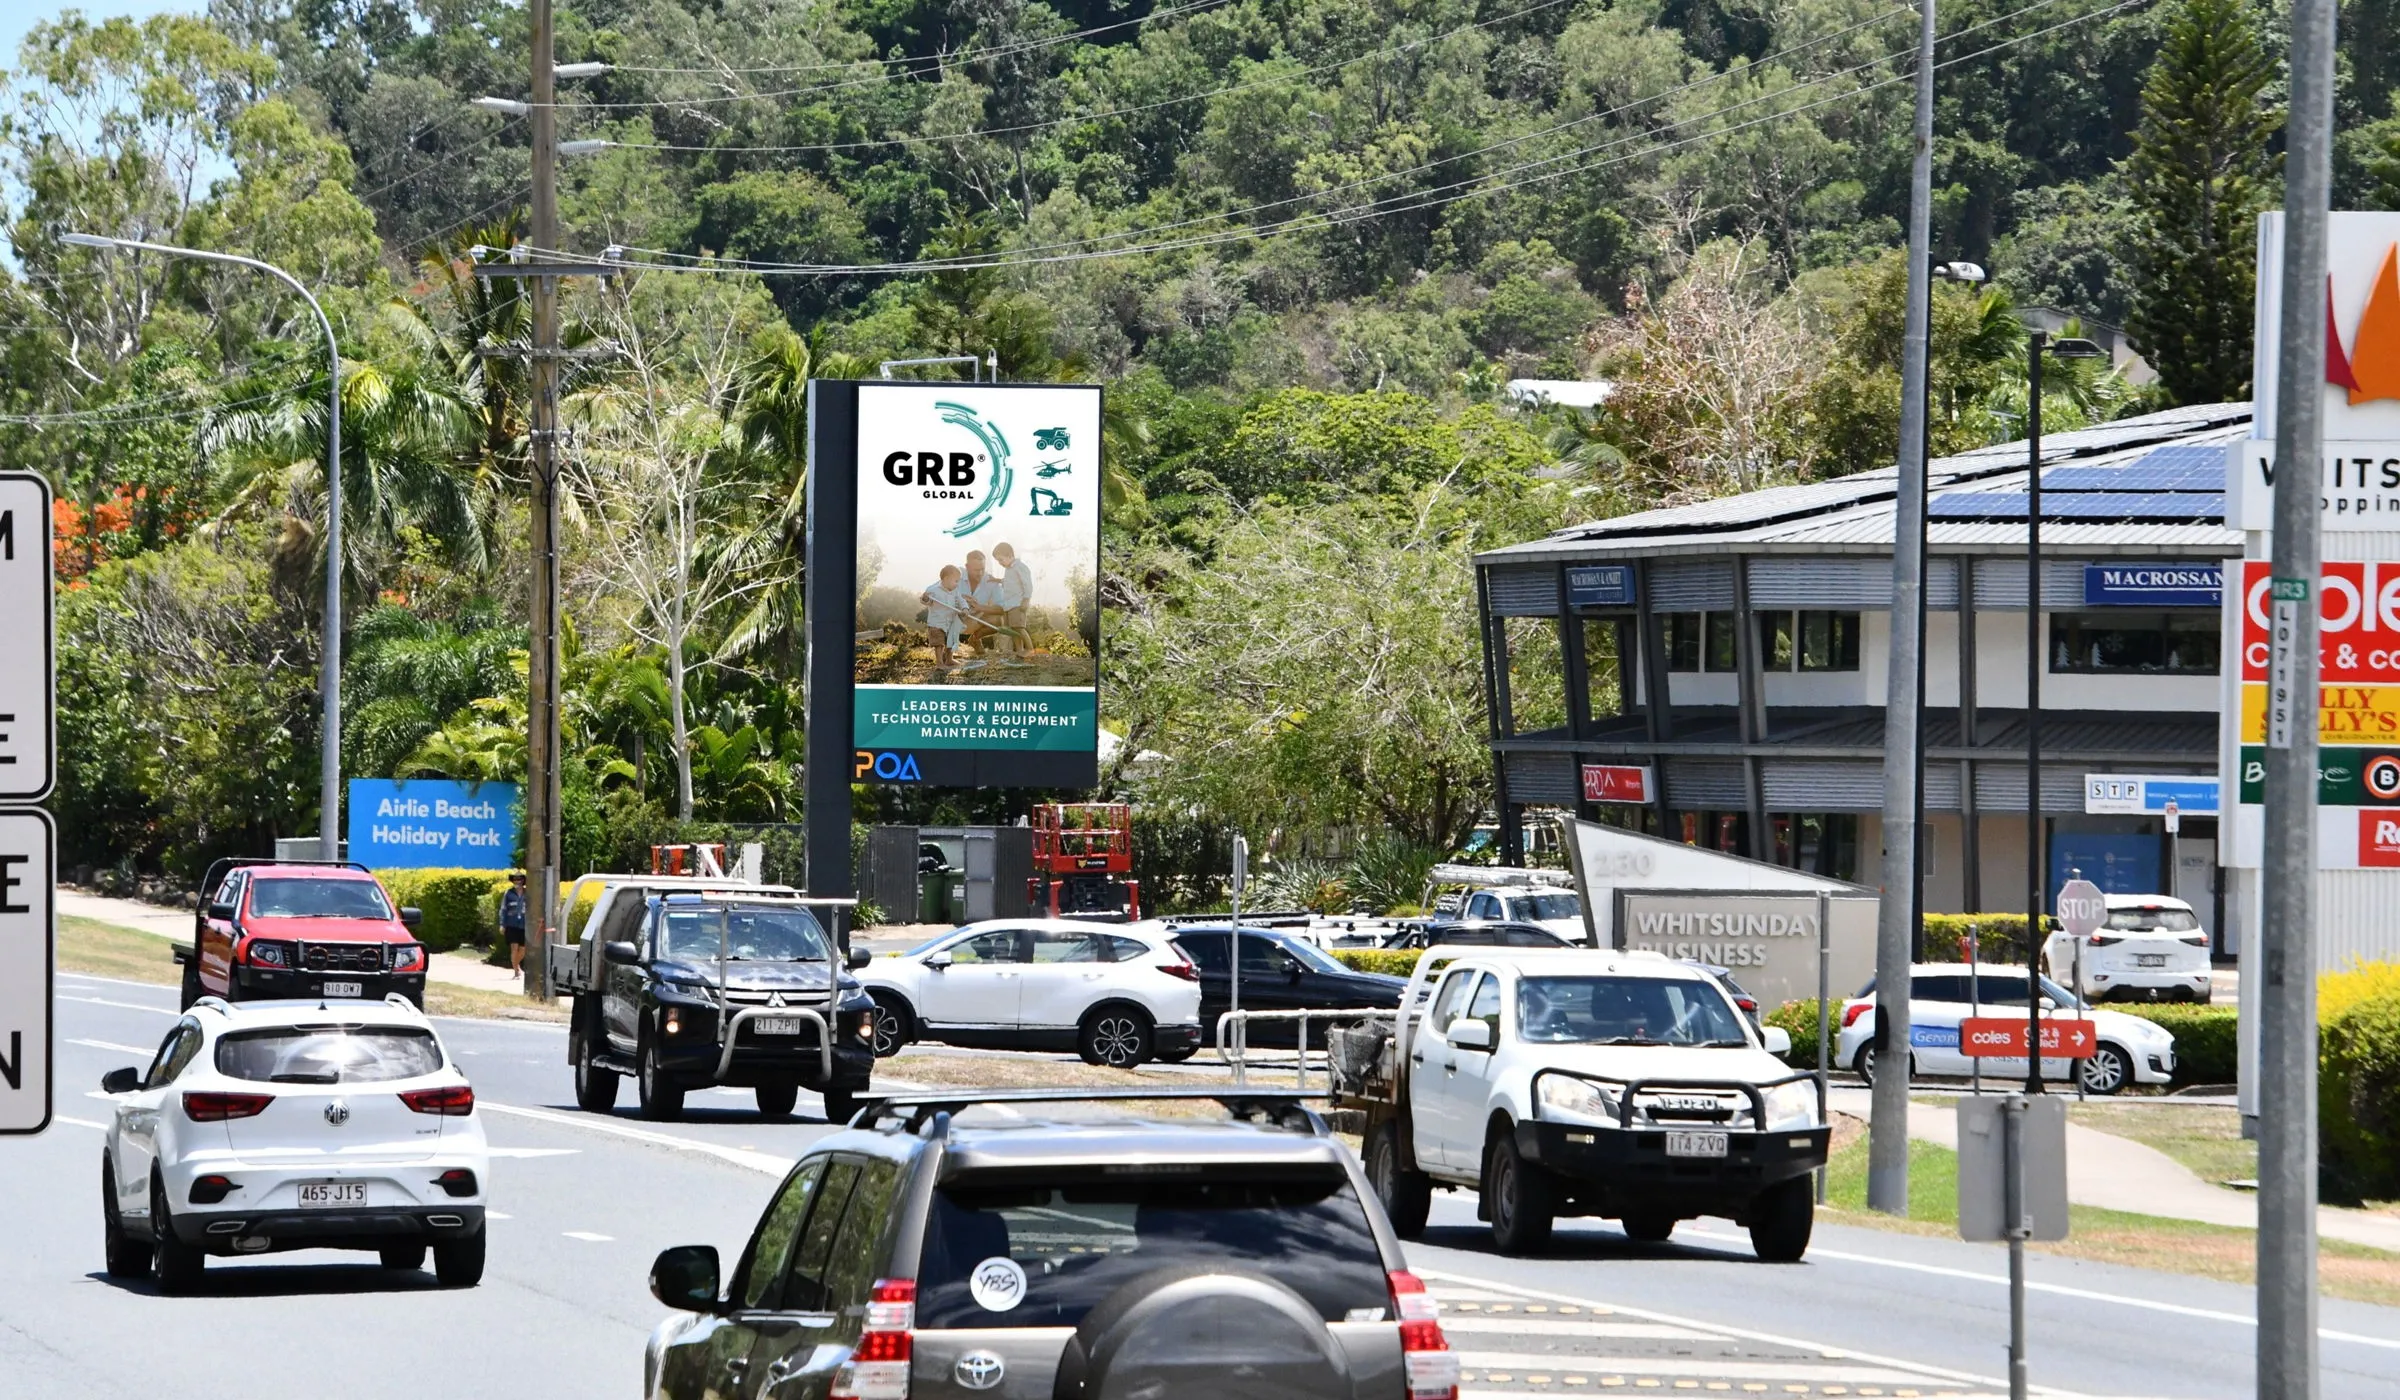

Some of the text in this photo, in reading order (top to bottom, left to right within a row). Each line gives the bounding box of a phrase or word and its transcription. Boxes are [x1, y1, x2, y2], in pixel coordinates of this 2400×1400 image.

[923, 490, 974, 499] GLOBAL
[2335, 643, 2359, 670] &
[902, 701, 1049, 713] LEADERS IN MINING
[872, 713, 1078, 727] TECHNOLOGY & EQUIPMENT
[921, 727, 1029, 739] MAINTENANCE
[855, 751, 922, 780] POA
[377, 798, 496, 819] Airlie Beach
[372, 824, 500, 850] Holiday Park
[2060, 898, 2104, 920] STOP
[1637, 912, 1821, 938] WHITSUNDAY
[1972, 1030, 2011, 1044] coles
[1663, 1098, 1718, 1110] ISUZU
